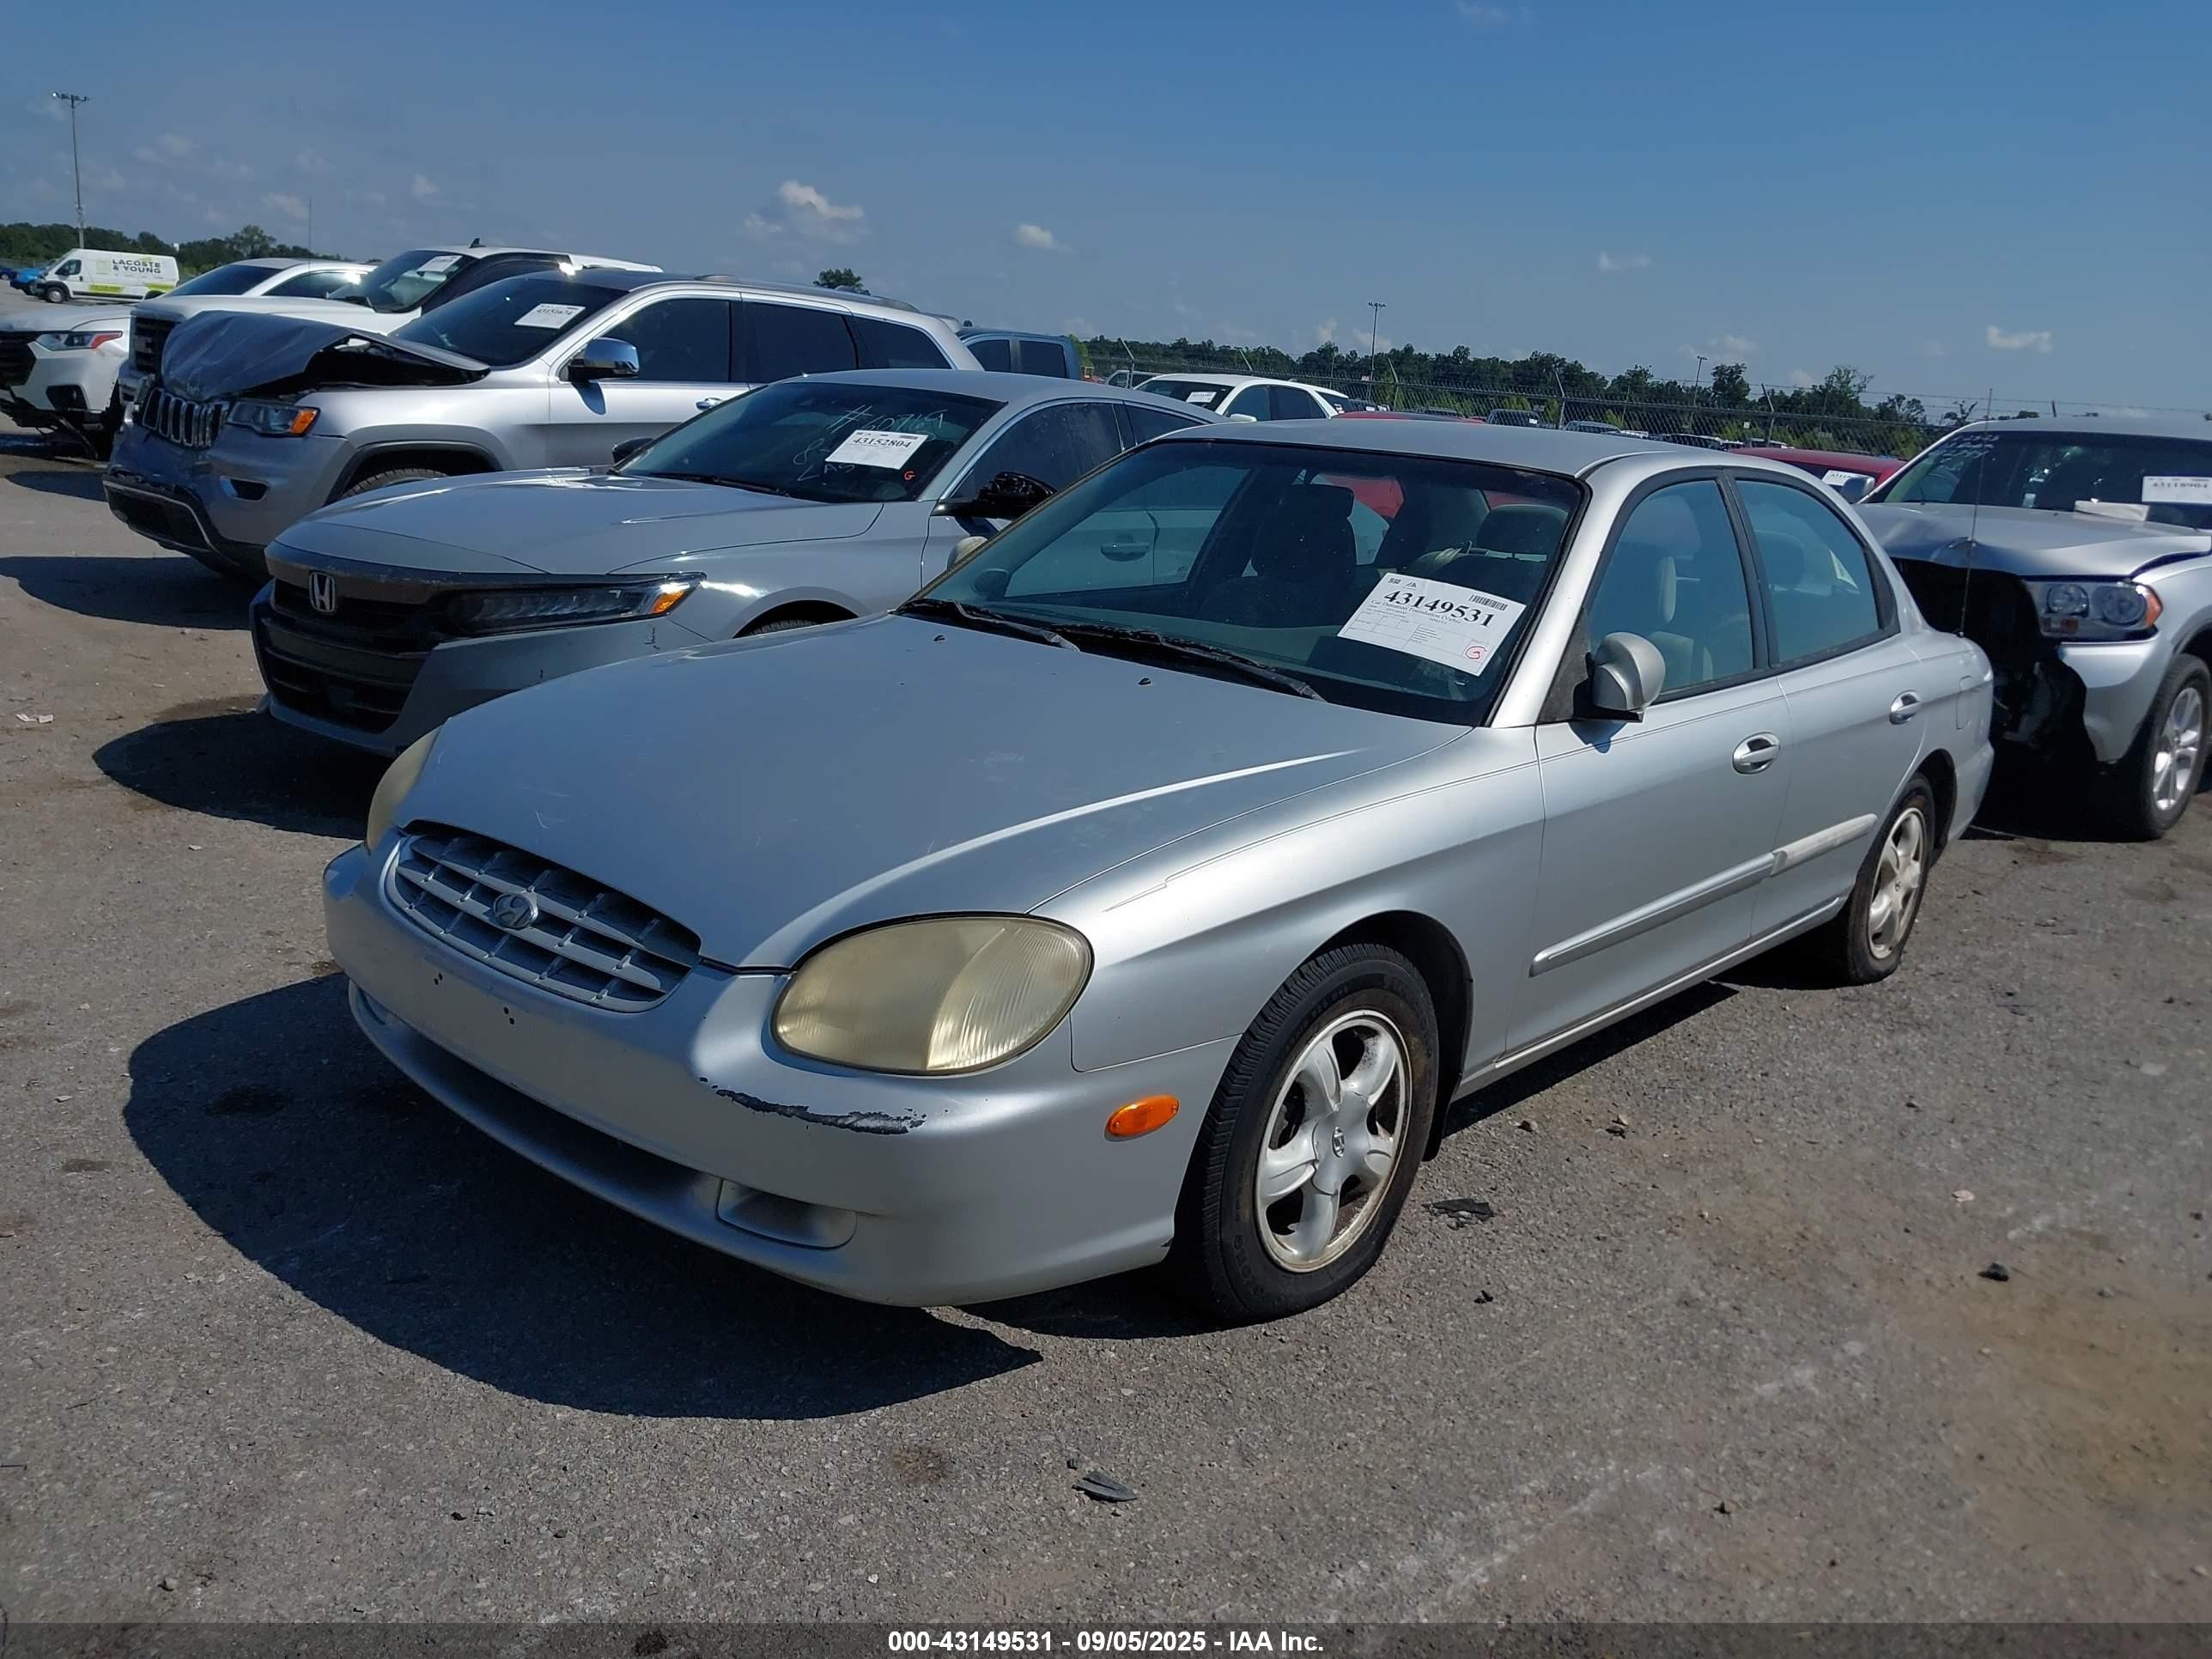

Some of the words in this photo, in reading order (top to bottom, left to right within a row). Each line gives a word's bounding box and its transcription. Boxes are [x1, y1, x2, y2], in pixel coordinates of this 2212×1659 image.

[112, 258, 161, 268] LACOSTE
[123, 265, 161, 274] YOUNG
[852, 437, 912, 449] 43152804
[1383, 590, 1494, 629] 43149531
